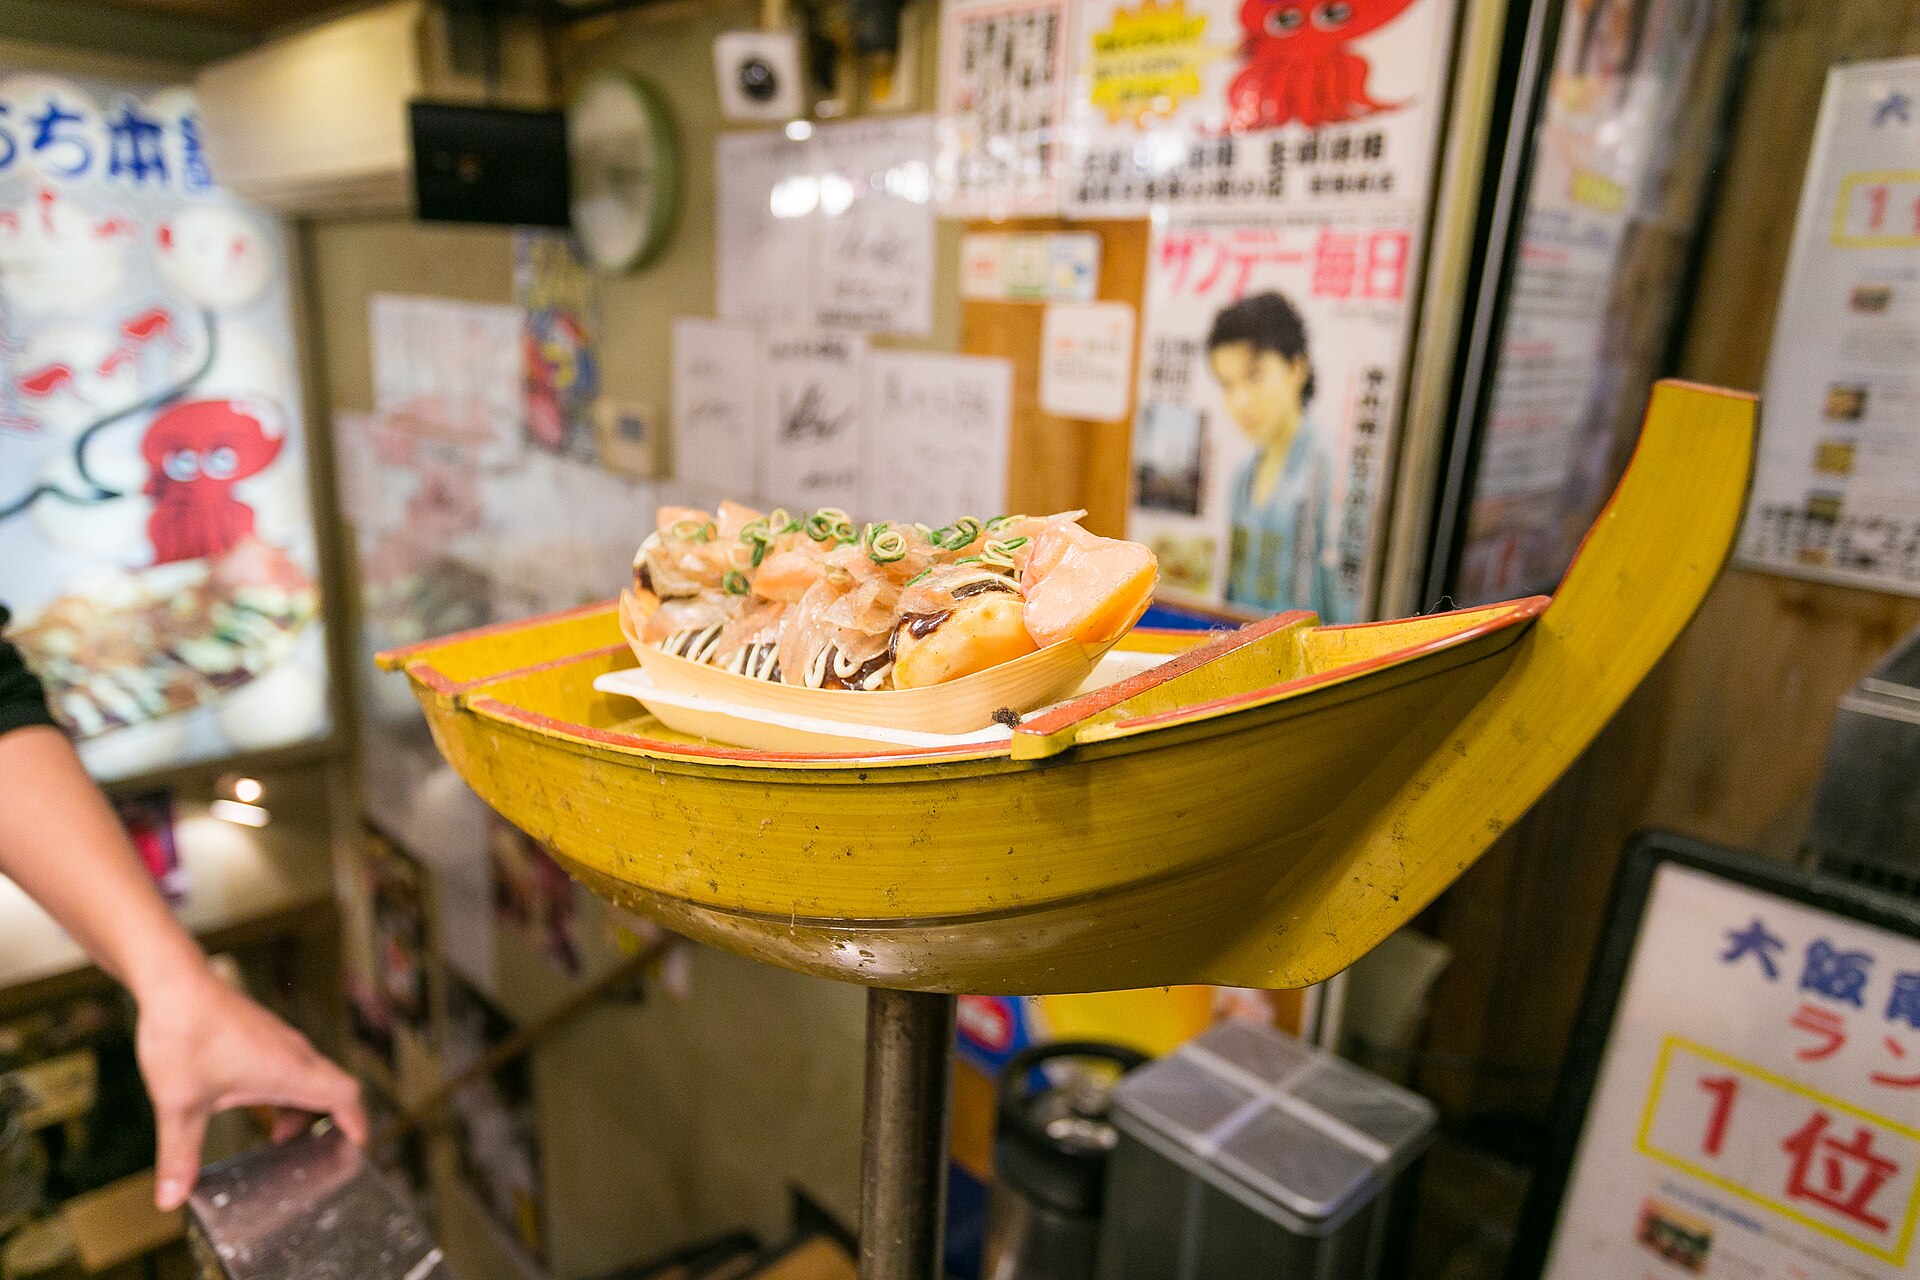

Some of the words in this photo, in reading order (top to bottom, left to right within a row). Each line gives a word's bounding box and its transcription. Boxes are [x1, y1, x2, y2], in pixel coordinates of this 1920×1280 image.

[1161, 229, 1410, 304] サンデー毎日
[1698, 1073, 1899, 1234] 1位
